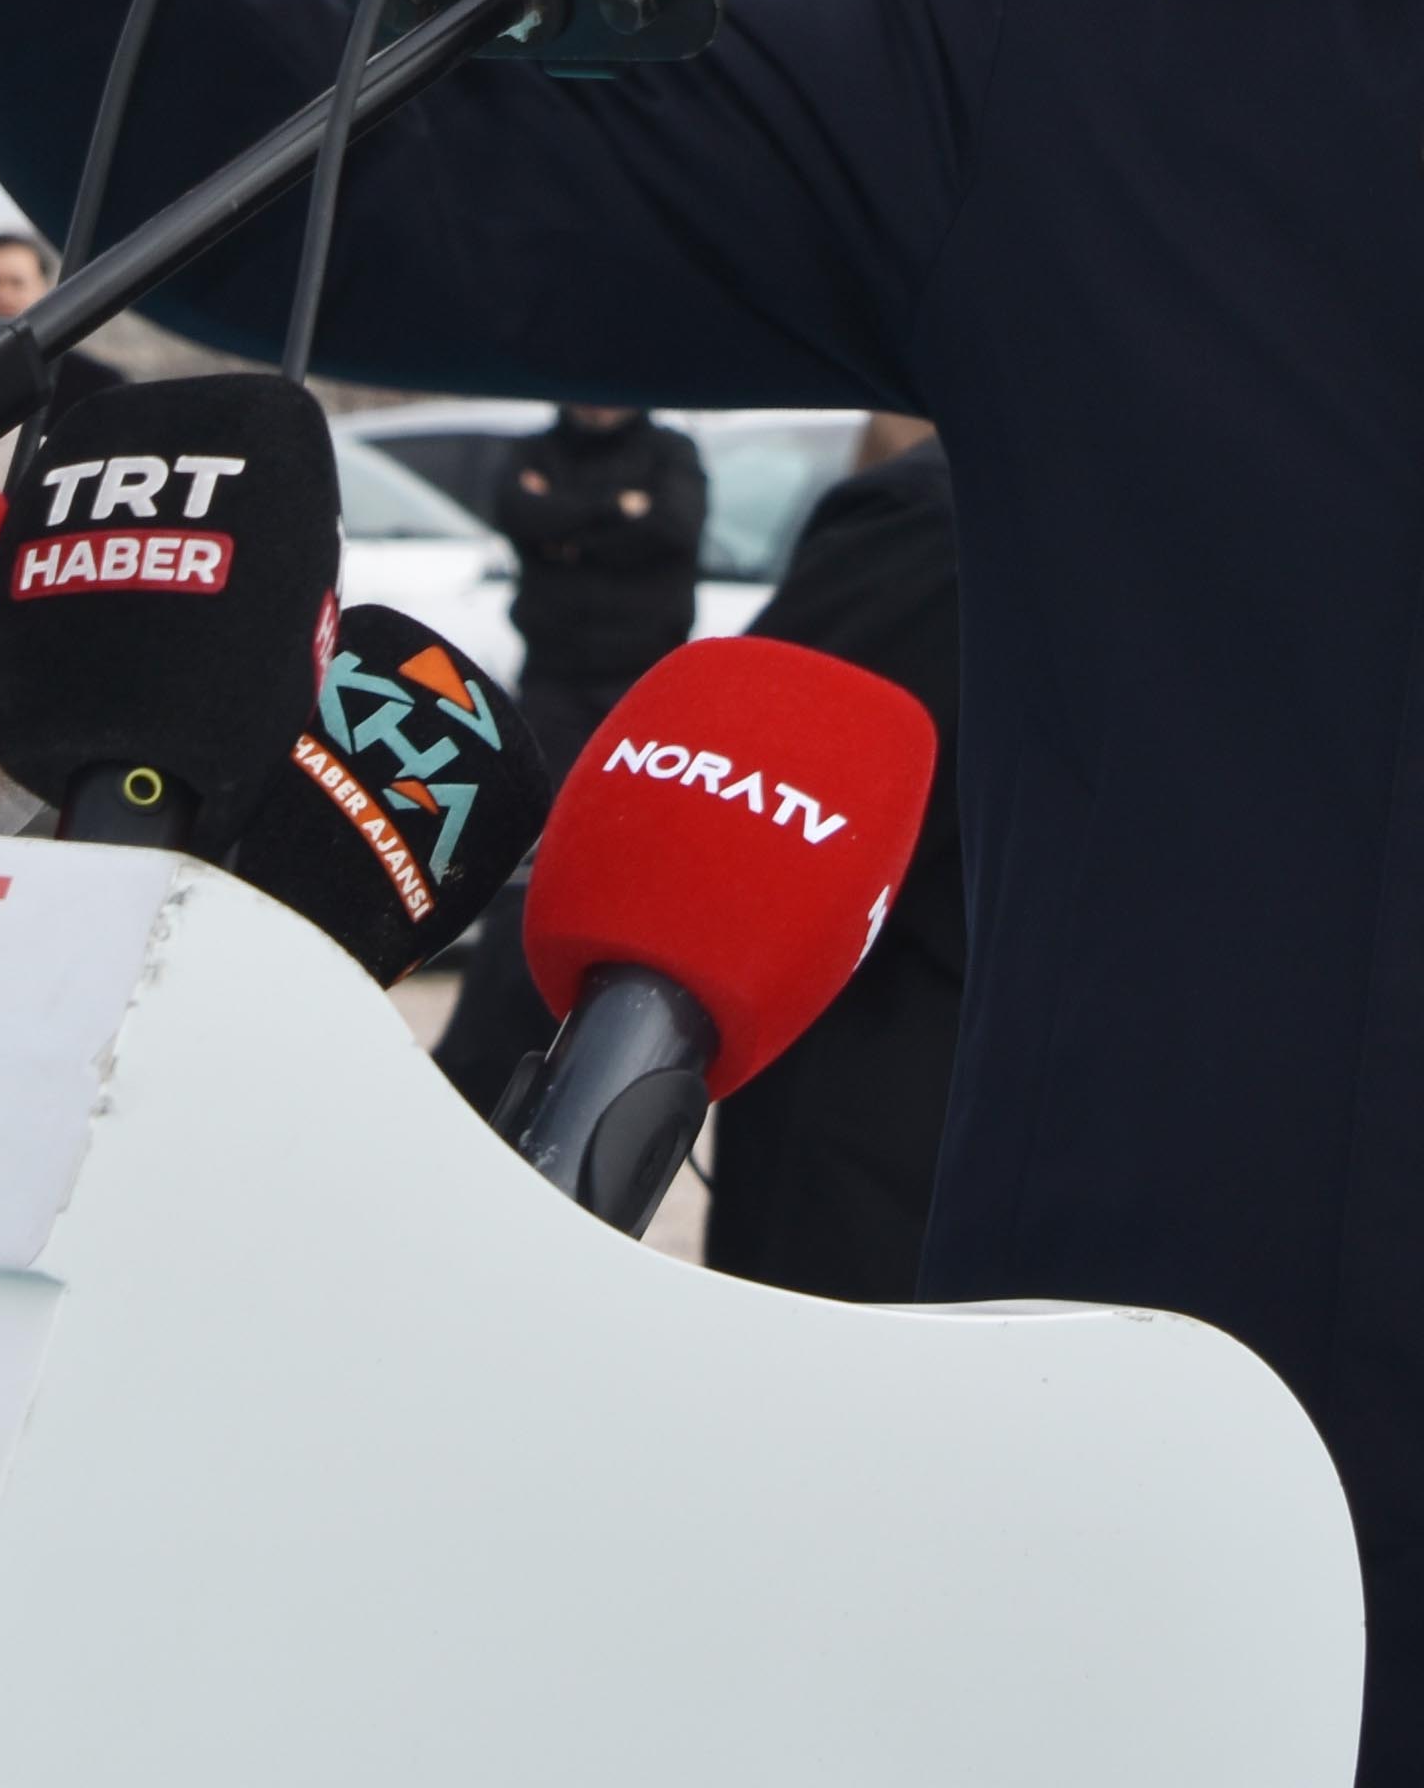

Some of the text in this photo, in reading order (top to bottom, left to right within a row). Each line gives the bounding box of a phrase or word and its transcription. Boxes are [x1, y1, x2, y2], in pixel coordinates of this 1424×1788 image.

[43, 455, 246, 526] TRT
[20, 537, 222, 590] HABER
[362, 818, 429, 922] AJANSI
